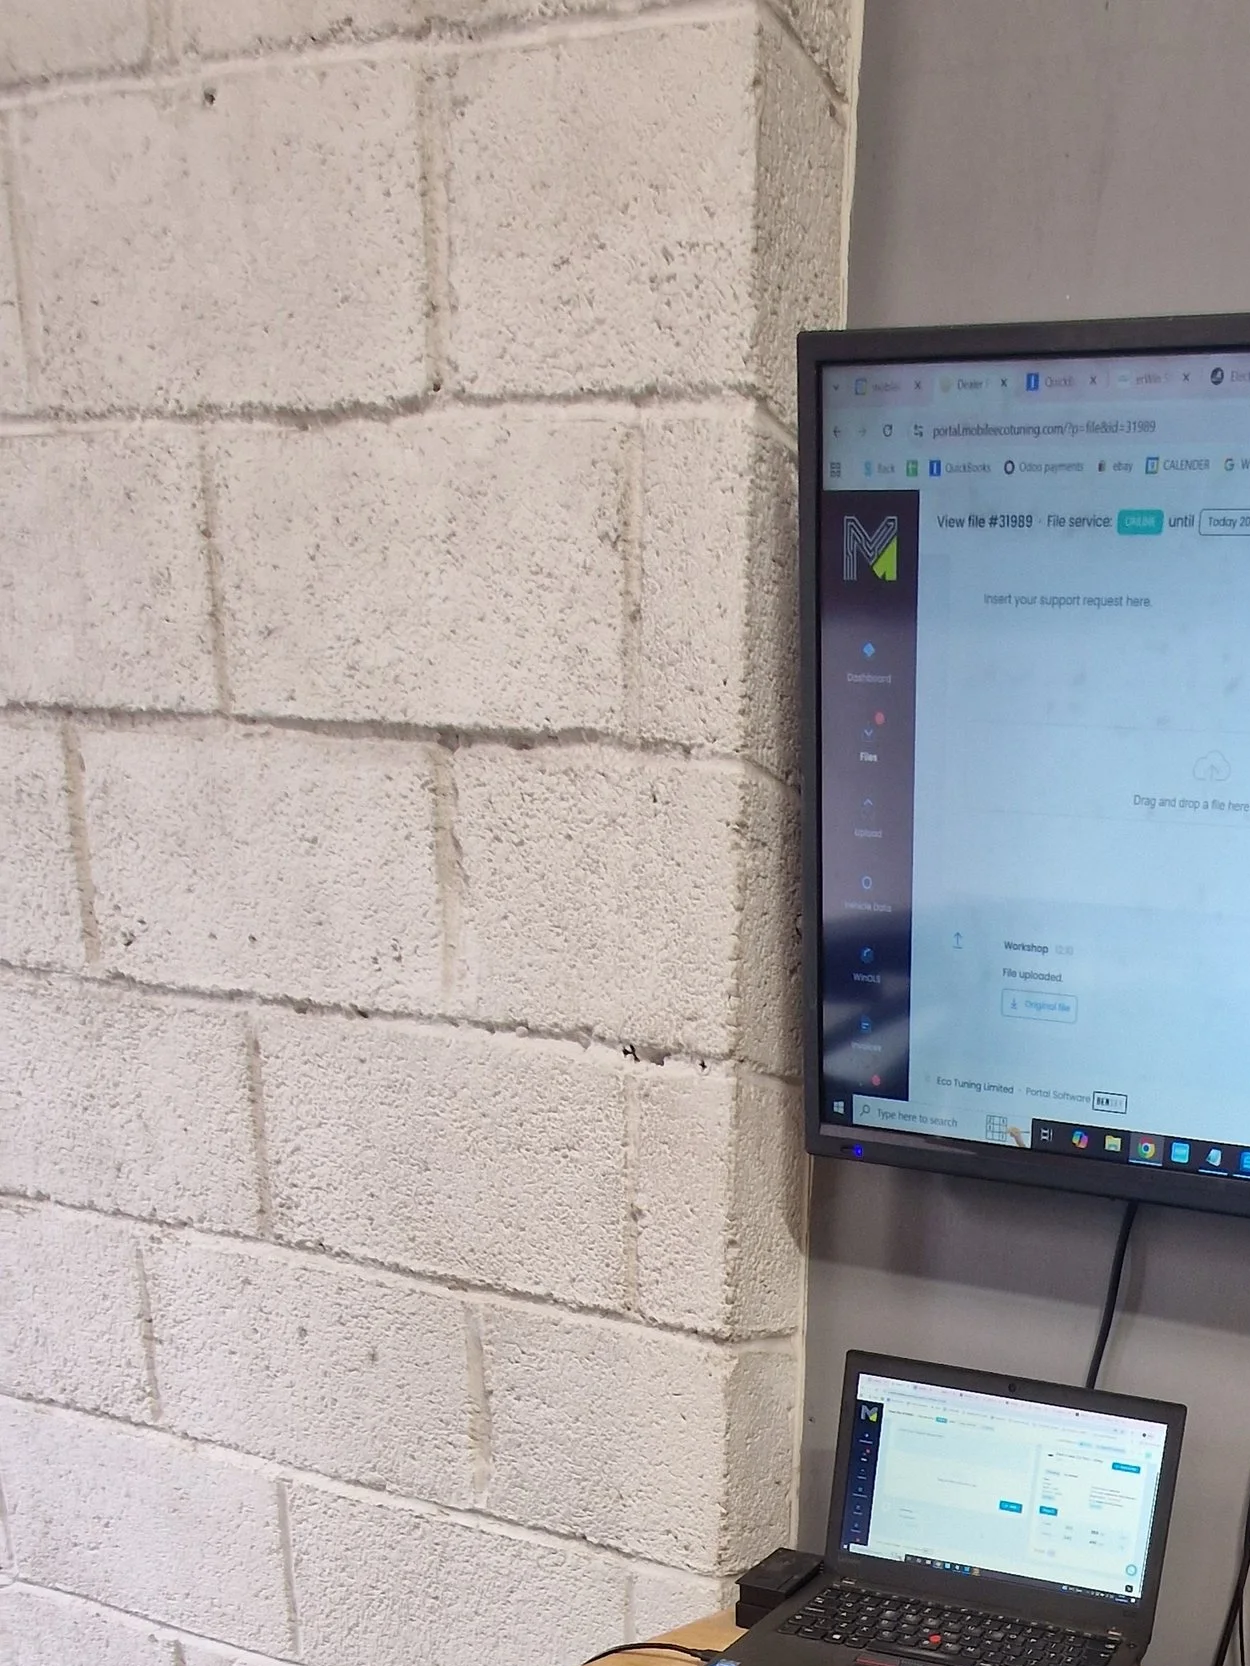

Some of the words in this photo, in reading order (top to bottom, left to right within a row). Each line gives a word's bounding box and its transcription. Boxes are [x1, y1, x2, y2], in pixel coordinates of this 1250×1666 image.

[1163, 458, 1210, 472] CALENDER
[937, 514, 965, 529] View
[968, 513, 986, 528] file
[987, 514, 1033, 529] #31989
[1047, 513, 1066, 528] File
[1068, 514, 1112, 529] service:
[1168, 513, 1195, 528] until
[1208, 515, 1237, 531] Today
[984, 593, 1012, 606] Insert
[1013, 595, 1038, 609] your
[1040, 594, 1080, 610] support
[1082, 595, 1123, 611] request
[1125, 595, 1153, 608] here.
[1133, 794, 1156, 810] Drag
[1158, 796, 1177, 808] and
[1178, 797, 1201, 813] drop
[1211, 797, 1226, 812] file
[1228, 799, 1250, 813] here
[1003, 940, 1050, 956] Workshop
[1002, 967, 1018, 979] File
[937, 1076, 953, 1088] Eco
[953, 1077, 982, 1093] Tuning
[982, 1081, 1015, 1095] Limited
[1025, 1086, 1051, 1099] Portal
[1052, 1089, 1092, 1103] Software
[877, 1107, 897, 1122] Type
[897, 1110, 918, 1122] here
[929, 1115, 958, 1128] search
